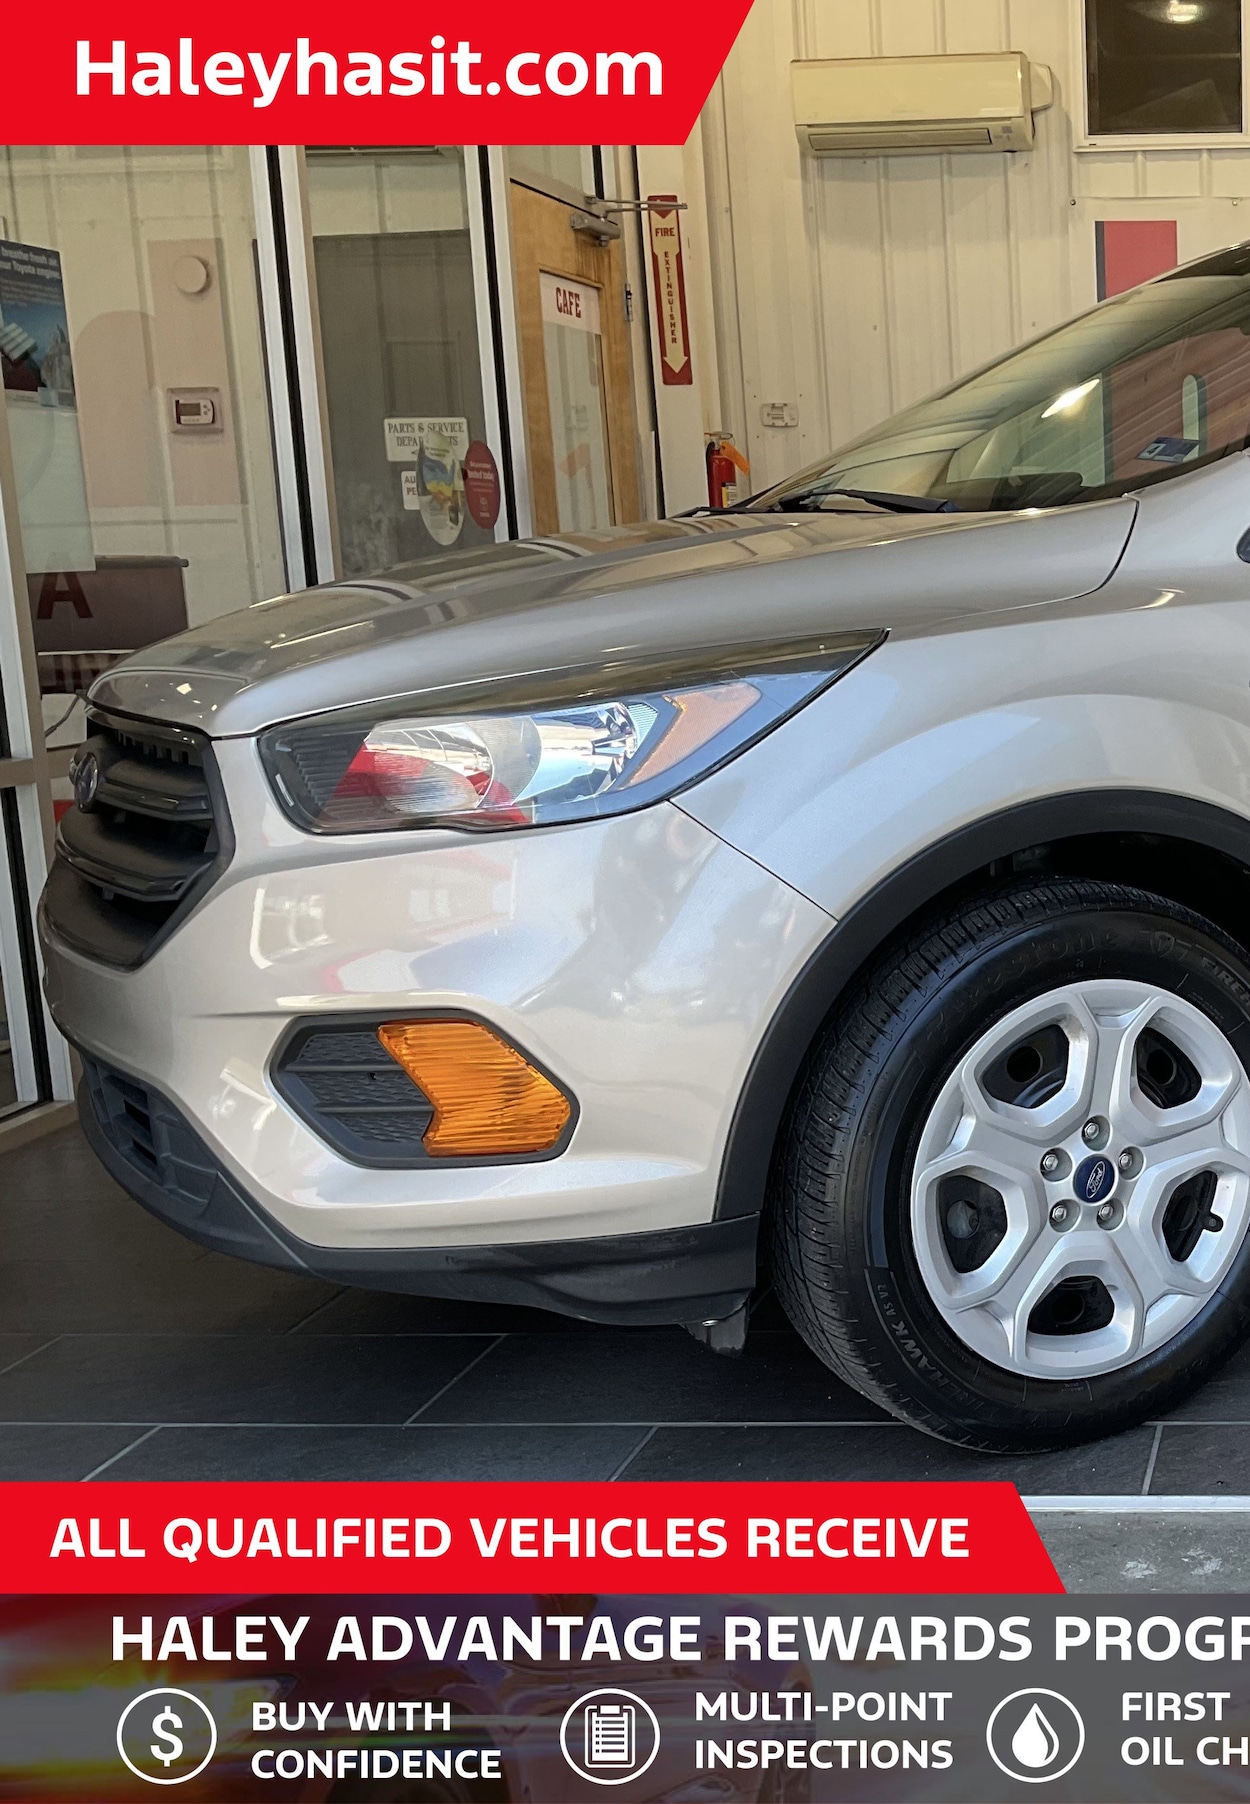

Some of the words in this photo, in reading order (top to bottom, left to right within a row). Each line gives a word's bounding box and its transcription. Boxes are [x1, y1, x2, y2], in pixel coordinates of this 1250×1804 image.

[655, 227, 675, 237] FIRE
[556, 287, 581, 319] CAFE
[664, 251, 677, 344] EXTINGUISHER
[388, 423, 415, 434] PARTS
[418, 424, 425, 433] &
[427, 422, 464, 434] SERVICE
[396, 436, 459, 447] DEPATS
